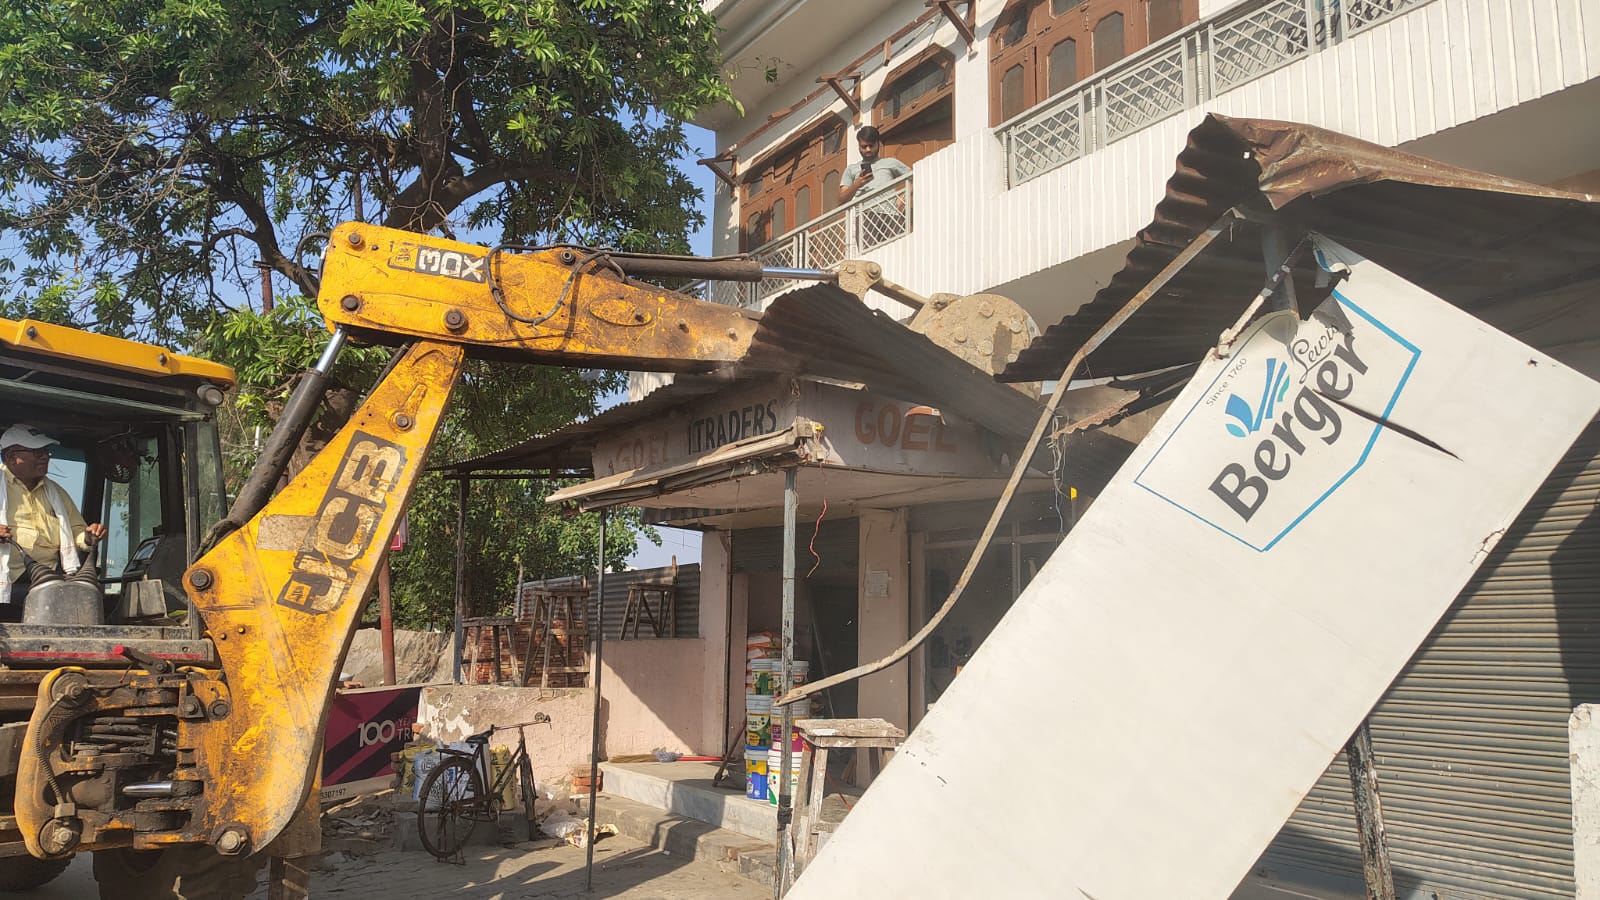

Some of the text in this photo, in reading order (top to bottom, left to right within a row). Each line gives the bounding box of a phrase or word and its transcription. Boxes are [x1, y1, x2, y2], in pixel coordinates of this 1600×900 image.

[1205, 357, 1248, 408] Since 1760
[855, 402, 957, 452] GOEL
[1208, 332, 1369, 523] Berger
[298, 440, 401, 612] JCB
[357, 719, 414, 748] 100 TR
